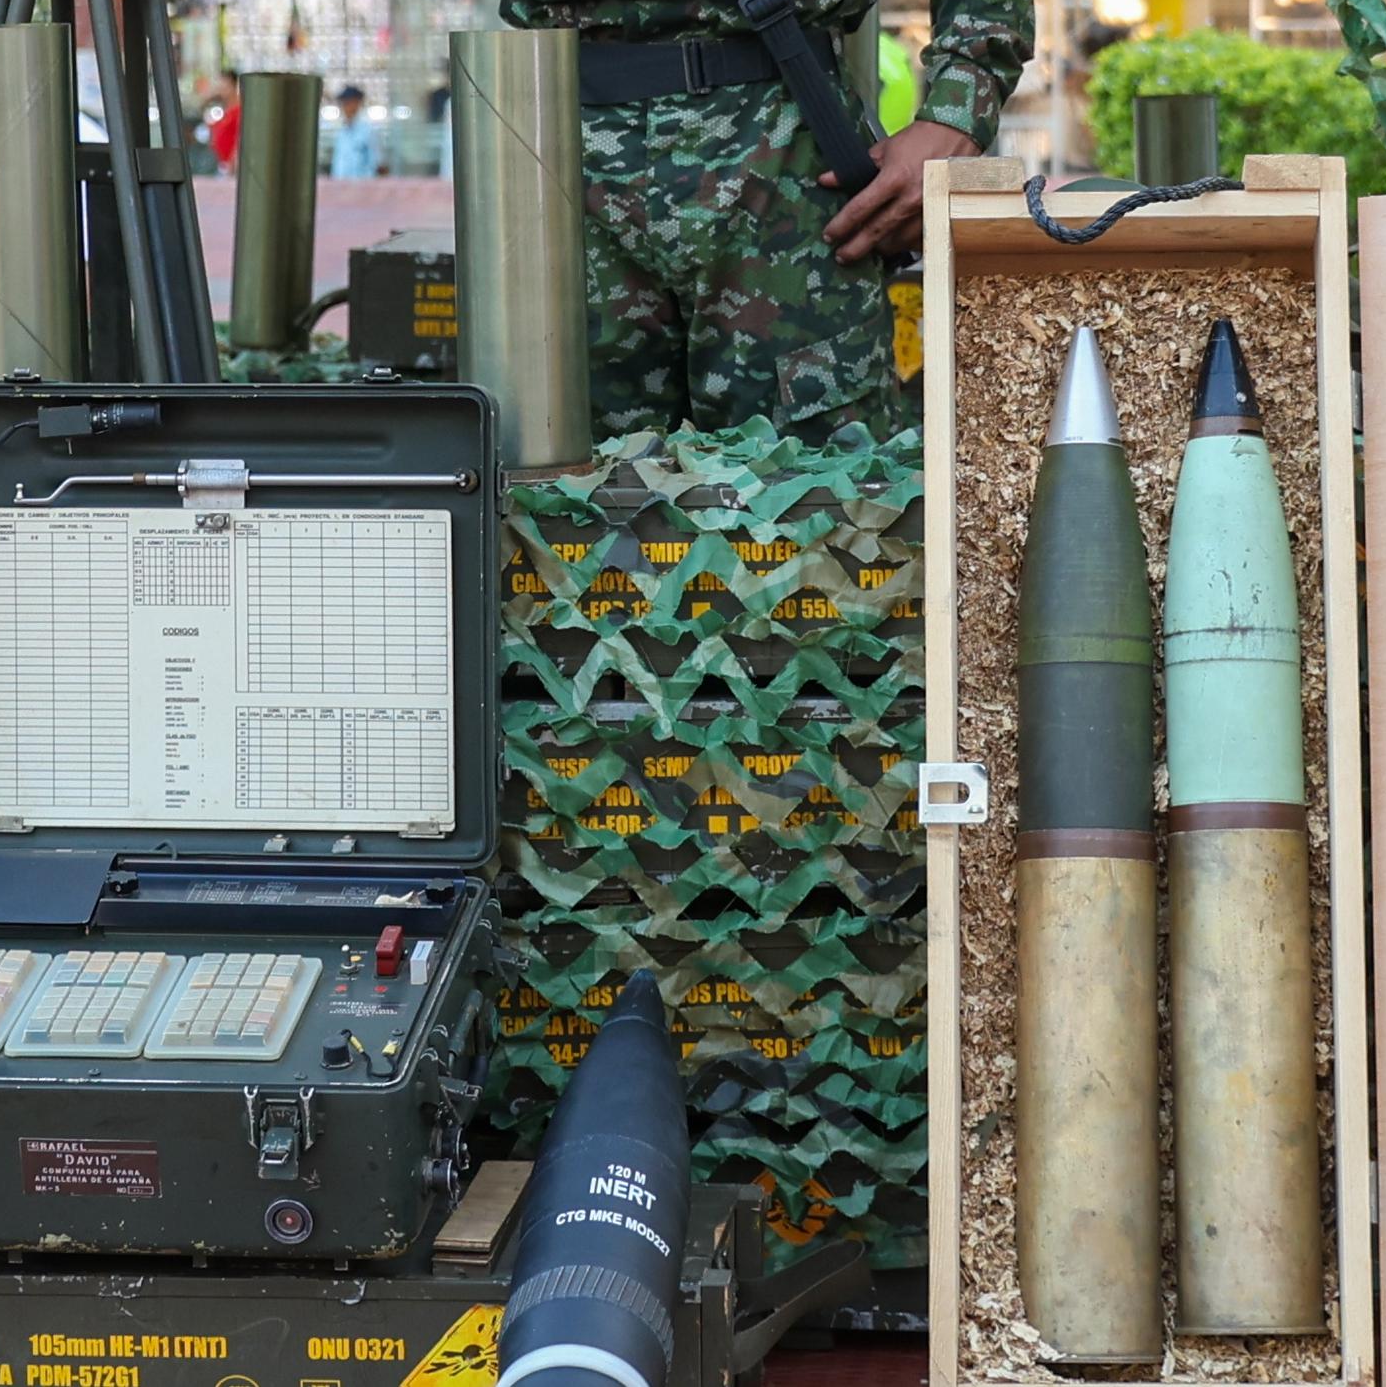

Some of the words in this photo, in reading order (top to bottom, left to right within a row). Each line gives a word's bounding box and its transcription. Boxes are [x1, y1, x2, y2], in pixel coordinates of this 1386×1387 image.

[40, 1142, 86, 1151] RAFAEL
[607, 1164, 631, 1179] 120
[634, 1172, 646, 1185] M
[589, 1177, 656, 1210] INERT
[556, 1210, 586, 1225] CTG
[589, 1210, 622, 1226] MKE
[29, 1333, 106, 1358] 105mm
[109, 1334, 170, 1358] HE-M1
[307, 1337, 350, 1360] ONU
[355, 1338, 405, 1361] 0321
[27, 1364, 139, 1387] PDM-572G1
